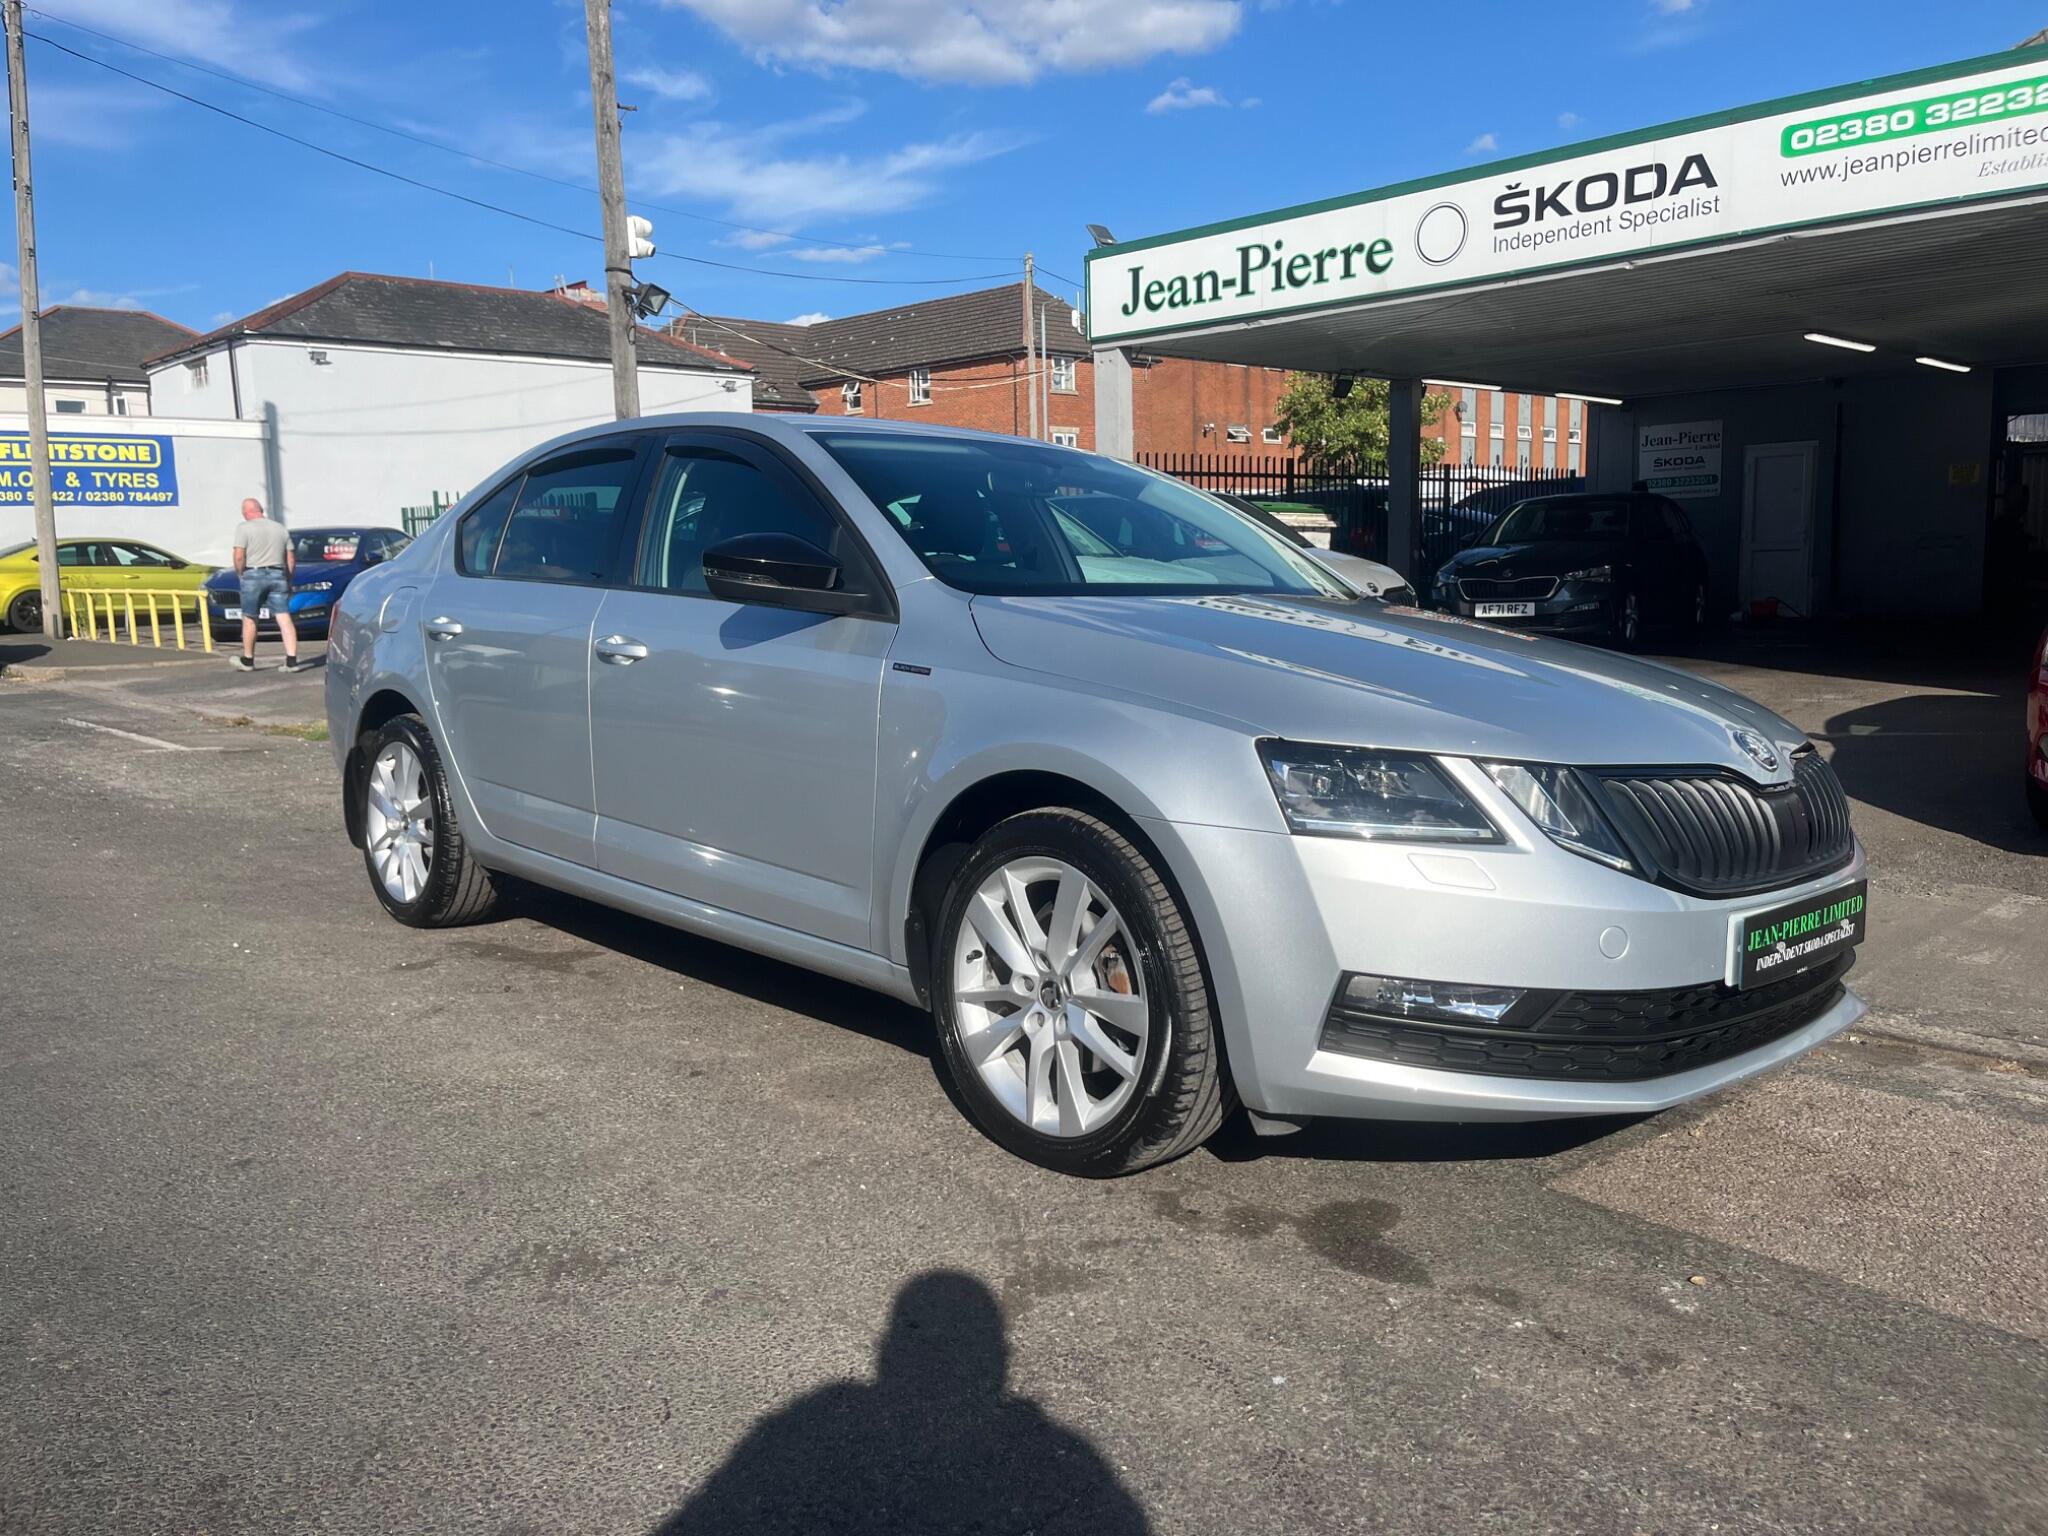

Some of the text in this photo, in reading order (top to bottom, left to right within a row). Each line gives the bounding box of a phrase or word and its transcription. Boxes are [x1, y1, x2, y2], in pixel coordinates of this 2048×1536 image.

[1790, 108, 1915, 151] 02380
[1976, 152, 2048, 178] Establi
[1493, 153, 1719, 230] ŠKODA
[1493, 194, 1721, 253] Independent Specialist
[1121, 238, 1394, 317] Jean-Pierre
[1641, 431, 1721, 448] Jean-Pierre
[26, 490, 75, 502] 5422
[85, 491, 125, 502] 02380
[127, 491, 174, 502] 784497
[65, 471, 81, 488] &
[91, 471, 160, 488] TYRES
[1481, 603, 1528, 616] AF71 RFZ
[1747, 895, 1863, 952] JEAN-PIERRE LIMITED
